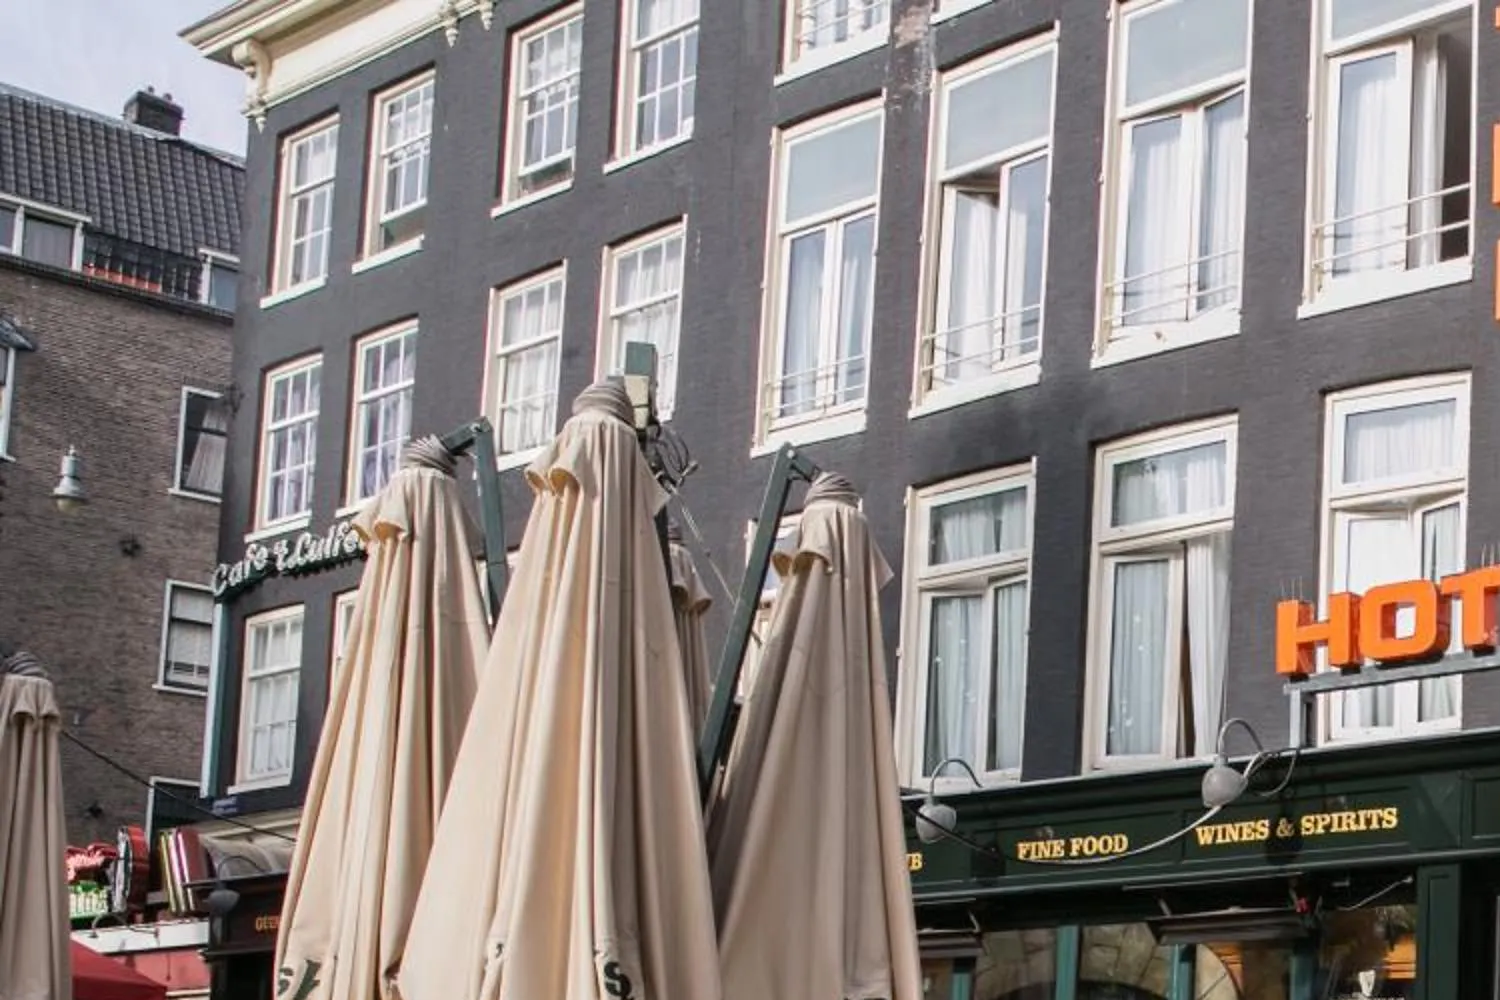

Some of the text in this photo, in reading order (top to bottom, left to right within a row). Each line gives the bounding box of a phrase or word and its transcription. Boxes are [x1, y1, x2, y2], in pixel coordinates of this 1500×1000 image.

[1196, 807, 1398, 846] WINES & SPIRITS
[1017, 834, 1129, 861] FINE FOOD
